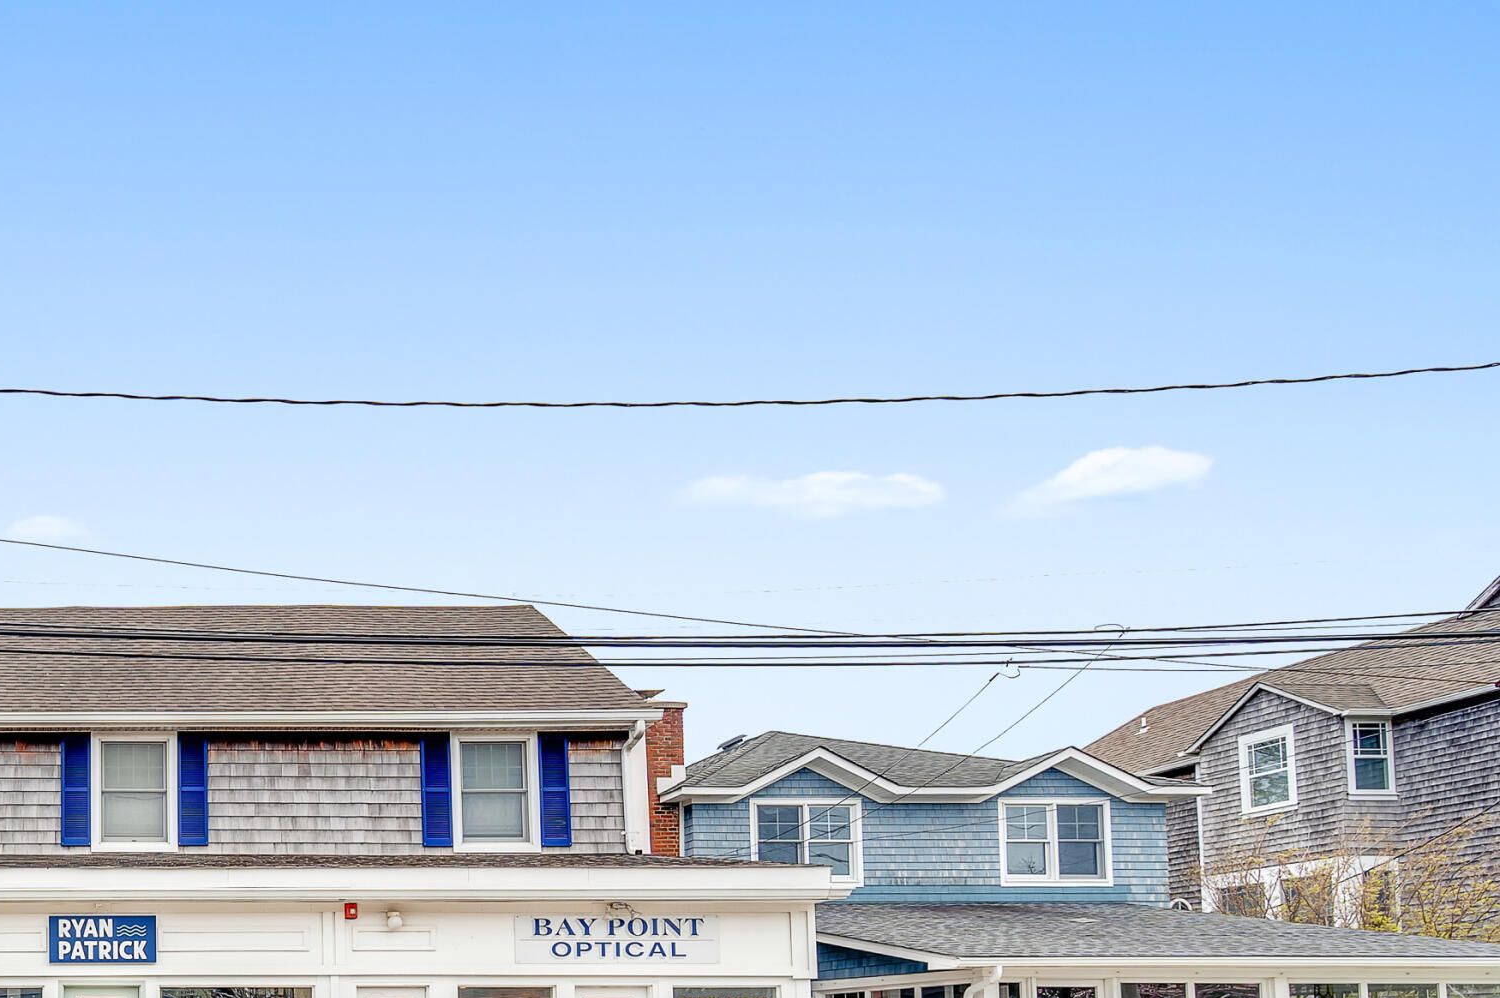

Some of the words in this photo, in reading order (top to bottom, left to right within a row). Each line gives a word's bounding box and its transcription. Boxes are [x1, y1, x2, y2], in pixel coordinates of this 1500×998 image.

[58, 918, 113, 938] RYAN
[533, 917, 598, 936] BAY
[607, 917, 704, 936] POINT
[58, 940, 147, 960] PATRICK
[551, 941, 687, 957] OPTICAL
